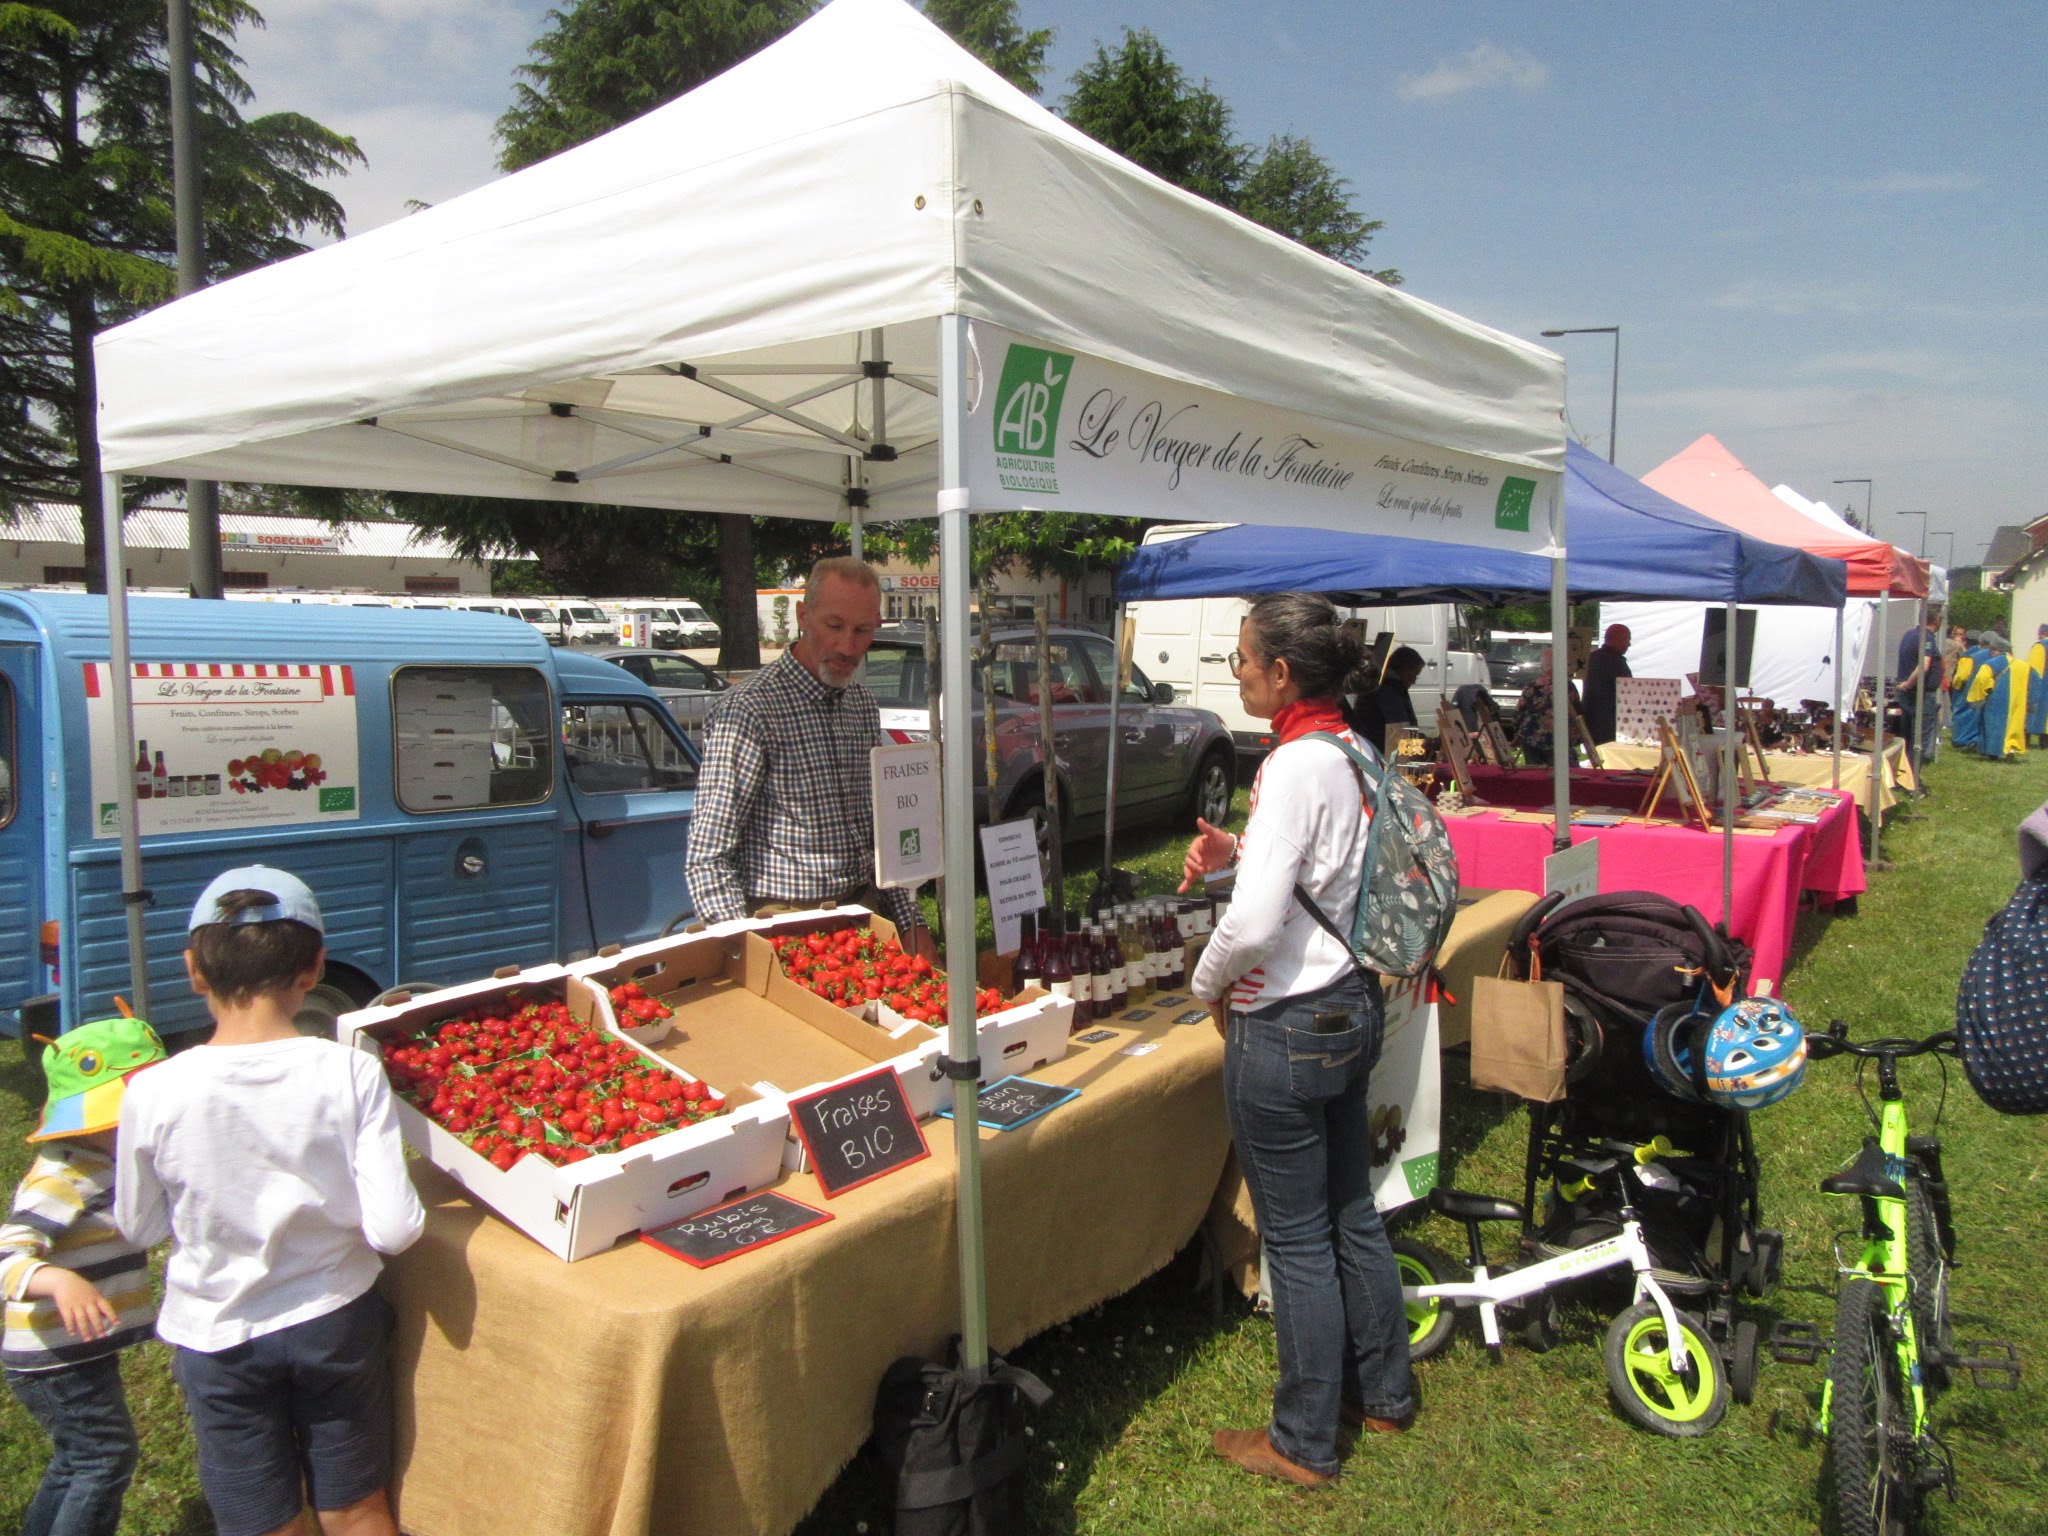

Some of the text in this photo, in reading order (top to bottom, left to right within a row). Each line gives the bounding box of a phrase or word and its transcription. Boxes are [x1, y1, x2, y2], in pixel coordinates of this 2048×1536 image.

[998, 380, 1050, 451] AB
[1069, 387, 1355, 492] Le Verger de la Fontaine
[996, 456, 1056, 474] AGRICULTURE
[999, 473, 1059, 490] BIOLOGIQUE
[1377, 482, 1396, 509] Le
[1393, 497, 1412, 511] vrai
[1430, 497, 1442, 515] des
[1440, 497, 1463, 523] fruits
[257, 535, 324, 547] SOGECLIMA
[900, 575, 940, 587] SOGE
[157, 681, 301, 701] Le Verger de la Fontaine
[272, 707, 300, 717] Sorbets
[883, 761, 929, 780] FRAISES
[896, 793, 919, 810] BIO
[901, 836, 918, 855] AB
[998, 833, 1022, 844] CONSIGNE
[989, 860, 1006, 869] REMISE
[1012, 856, 1019, 864] 10
[999, 872, 1032, 887] POUR CHAQUE
[999, 889, 1037, 905] RETOUR DE POTS
[978, 1087, 1019, 1108] anon
[989, 1094, 1035, 1112] 500g
[813, 1088, 892, 1134] Fraises
[1013, 1104, 1034, 1115] 6
[840, 1125, 894, 1170] BIO
[677, 1203, 769, 1236] Rubis
[709, 1216, 774, 1239] 500g
[735, 1224, 787, 1245] 6 €
